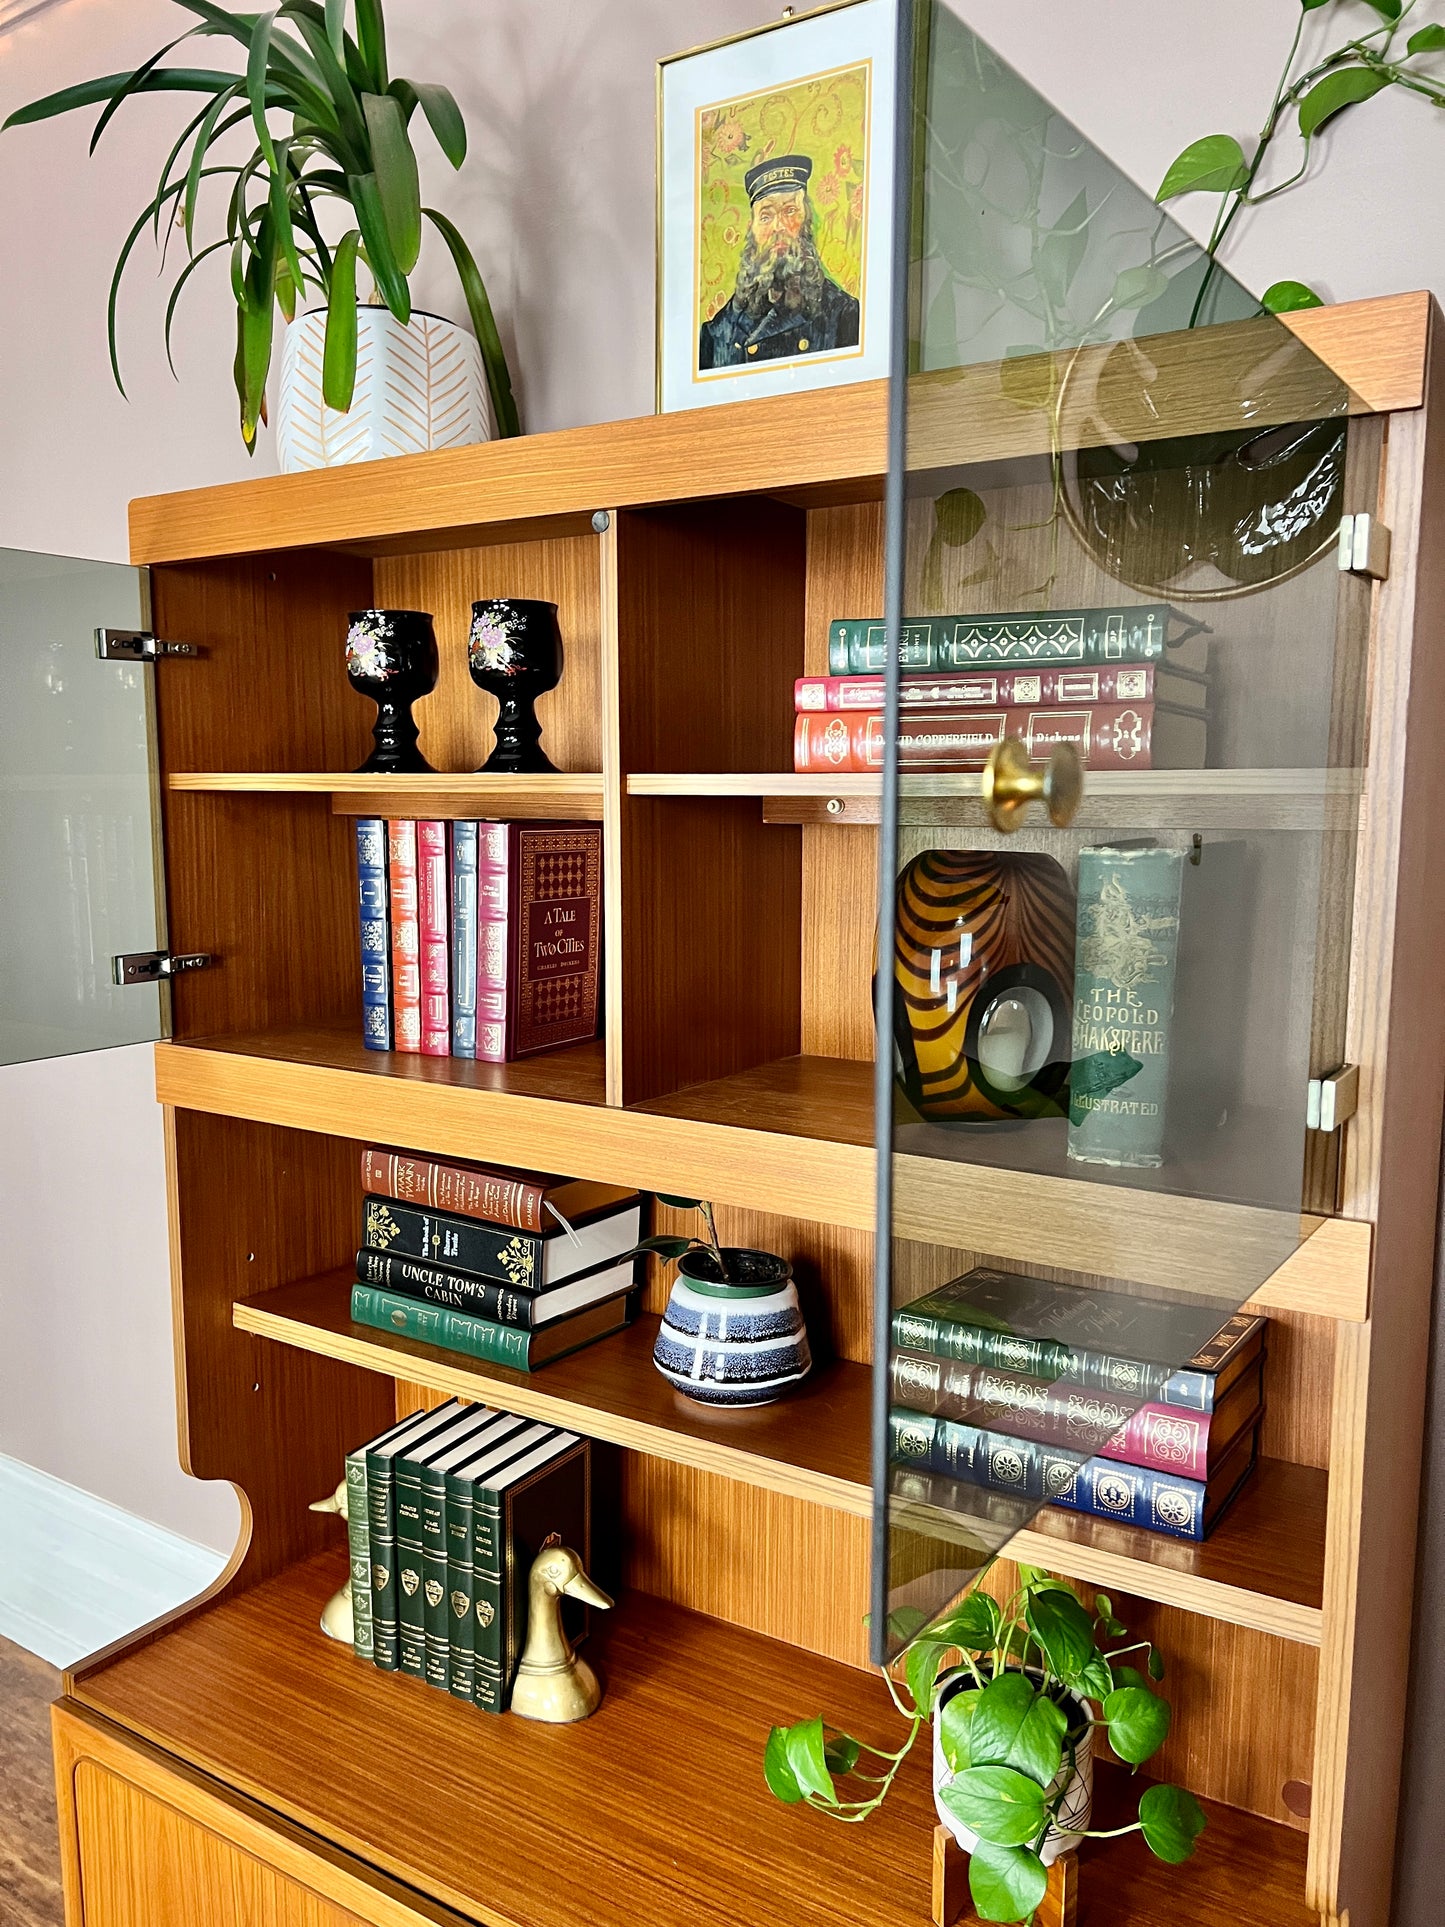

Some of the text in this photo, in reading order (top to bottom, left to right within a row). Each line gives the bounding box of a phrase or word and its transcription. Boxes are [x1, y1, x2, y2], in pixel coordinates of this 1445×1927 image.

[875, 733, 994, 746] DID COPPERFIELD
[1036, 731, 1081, 743] Dickens
[544, 911, 553, 925] A
[1090, 987, 1143, 1008] THE
[1076, 999, 1159, 1025] LEOPOLD
[398, 1164, 406, 1193] MARK
[405, 1162, 415, 1198] TWAIN
[402, 1264, 486, 1299] UNCLE TOM'S
[425, 1285, 463, 1307] CABIN
